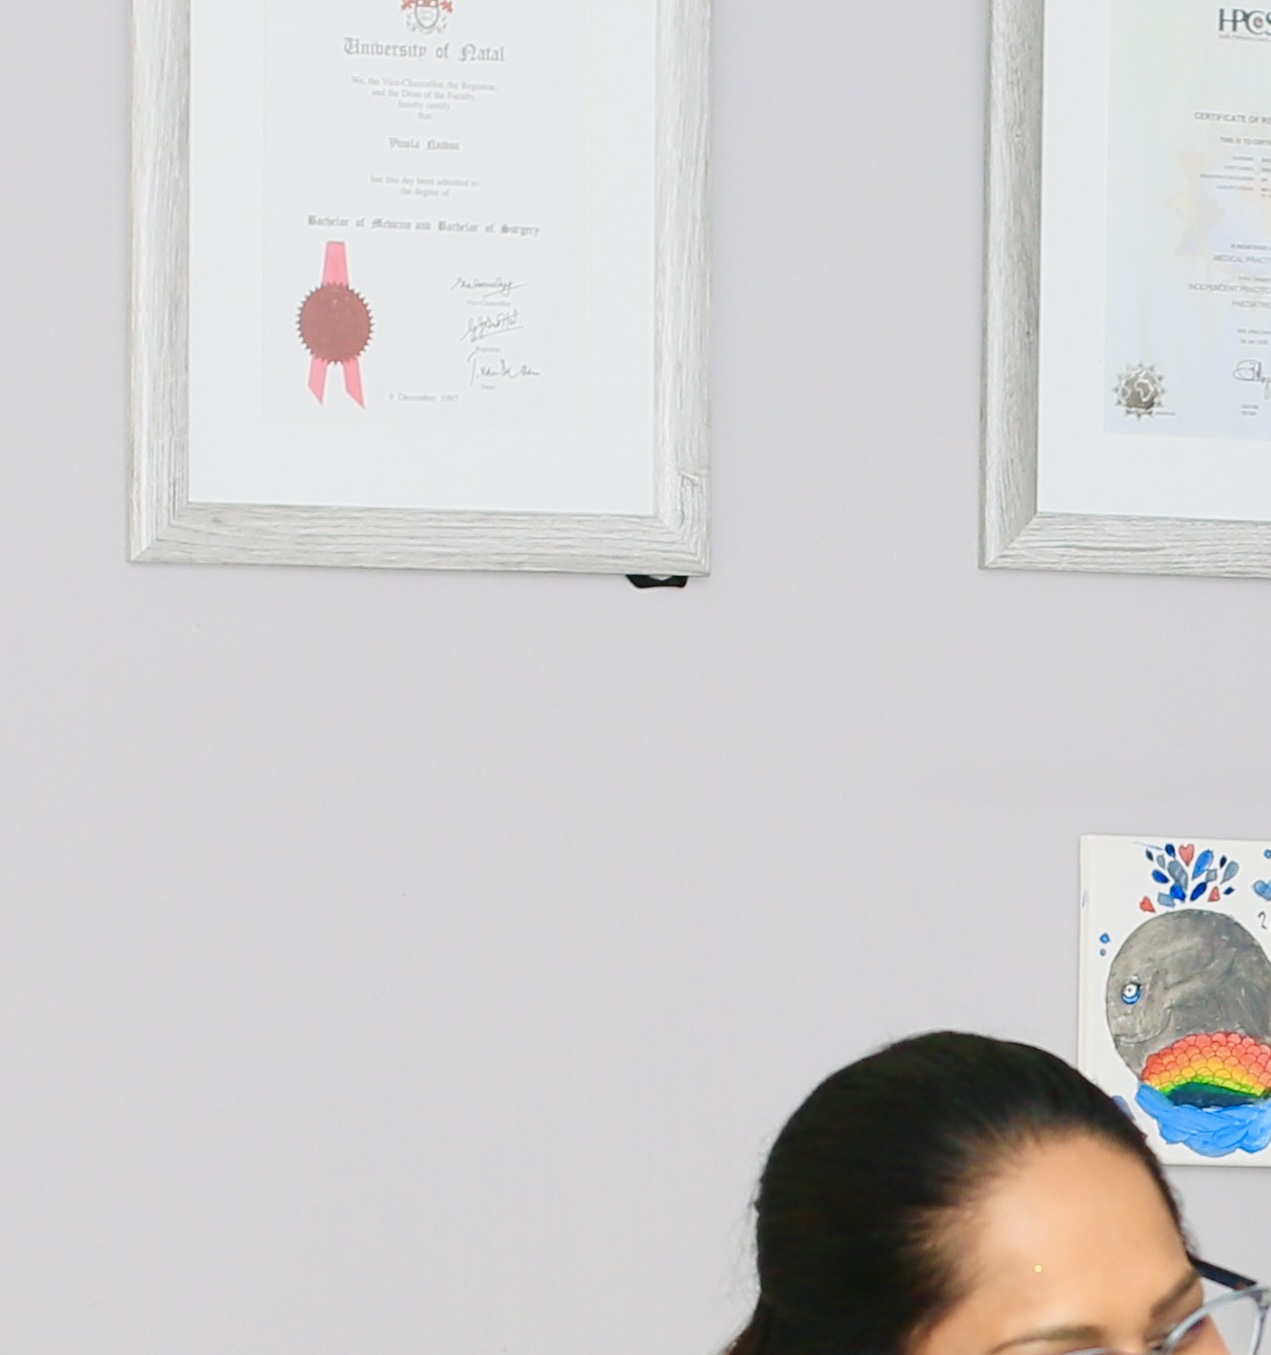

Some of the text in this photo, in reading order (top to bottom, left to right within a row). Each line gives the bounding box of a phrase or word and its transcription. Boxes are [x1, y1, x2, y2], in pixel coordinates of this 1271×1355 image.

[343, 37, 505, 62] University of Natal
[1194, 111, 1247, 123] CERTIFICATE
[1248, 115, 1259, 124] OF
